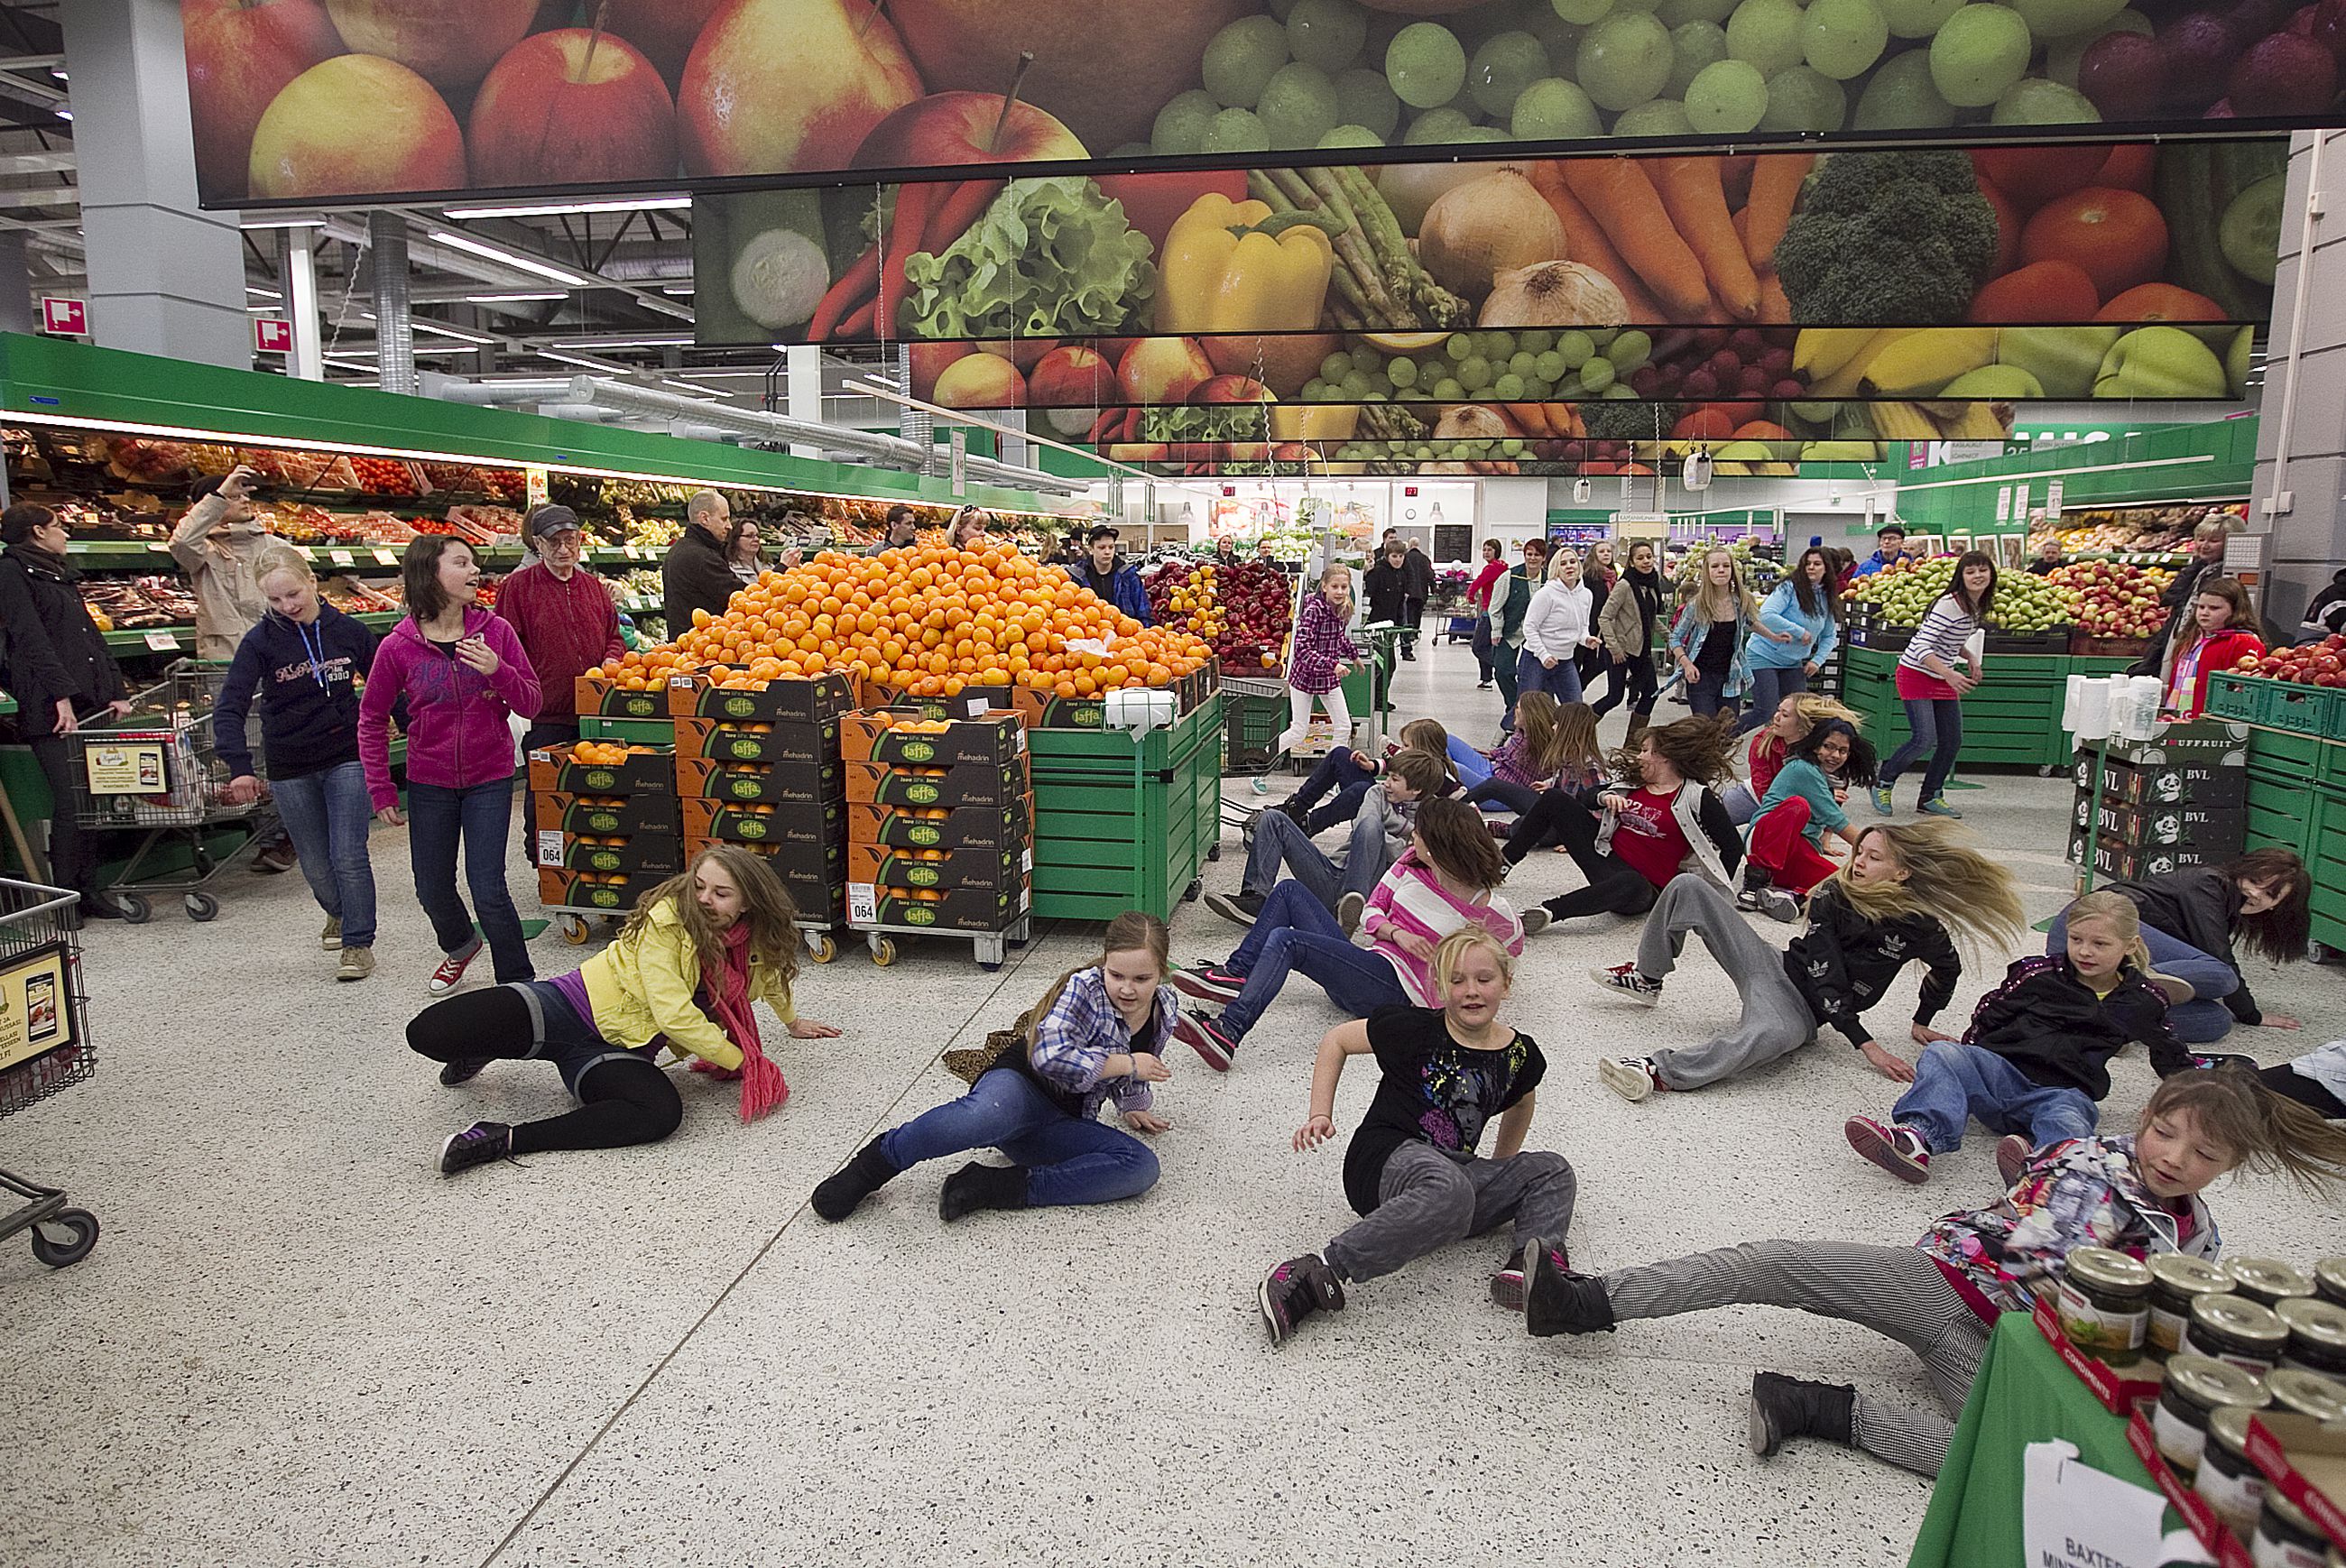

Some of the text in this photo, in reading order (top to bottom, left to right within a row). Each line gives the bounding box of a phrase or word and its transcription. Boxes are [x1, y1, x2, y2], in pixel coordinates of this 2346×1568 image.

[2101, 770, 2120, 792] VL
[2186, 770, 2211, 780] BVL
[2098, 807, 2120, 832] BVL
[2184, 812, 2209, 823] BVL
[542, 849, 560, 862] 064
[2178, 853, 2203, 864] BVL
[854, 905, 873, 918] 064
[2064, 1348, 2110, 1399] CONDIMENTS
[2066, 1537, 2131, 1568] BAXTE
